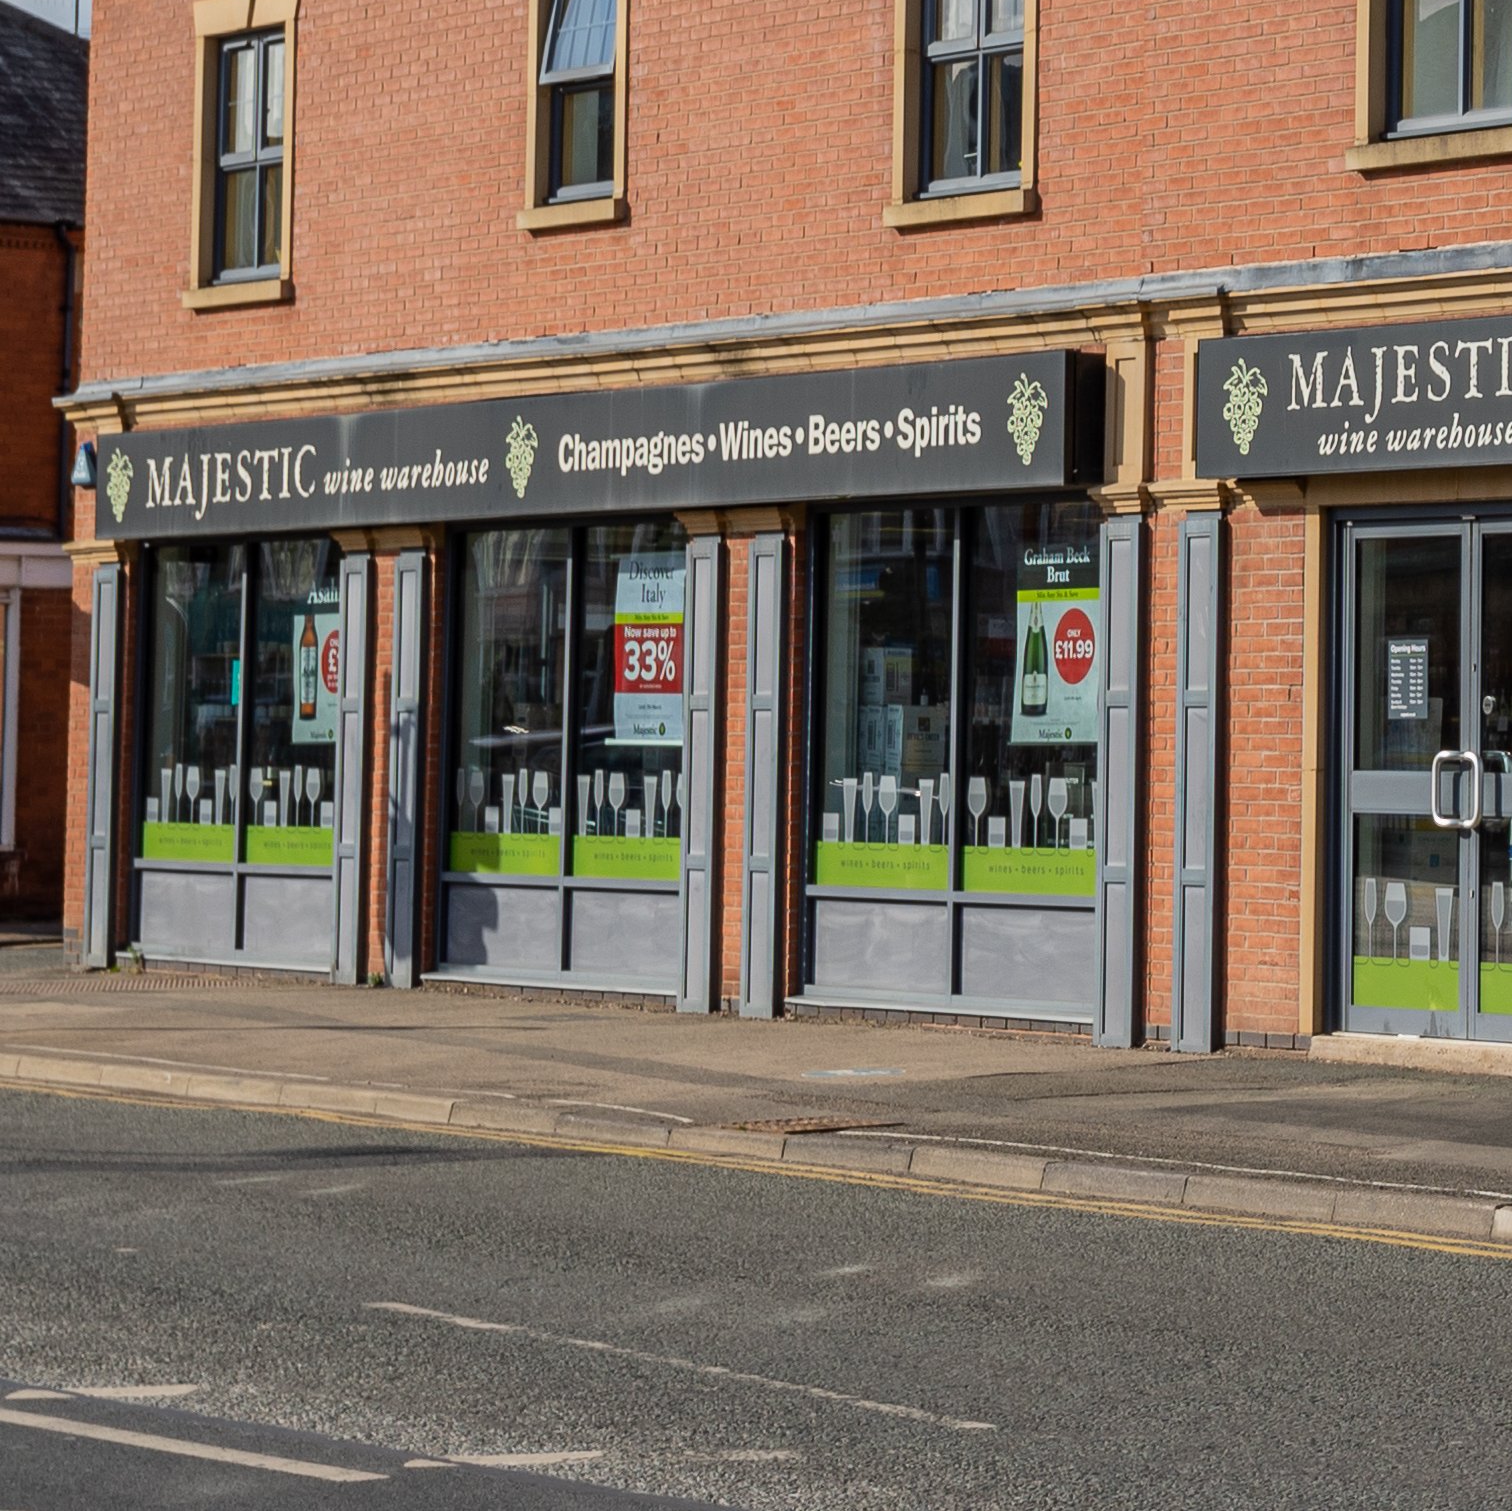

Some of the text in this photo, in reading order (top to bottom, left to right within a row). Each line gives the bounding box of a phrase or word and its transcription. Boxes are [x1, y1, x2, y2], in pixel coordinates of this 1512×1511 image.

[558, 405, 982, 476] Champagnes Wines Beers Spirits
[1317, 421, 1377, 456] wine
[146, 444, 489, 520] MAJESTIC wine warehouse
[1024, 545, 1090, 565] Graham Beck
[629, 561, 674, 580] Discover
[1047, 566, 1070, 583] Brut
[307, 578, 339, 604] Asah
[641, 582, 666, 608] Italy
[624, 640, 675, 681] 33%
[1055, 640, 1094, 659] £11.99
[988, 865, 1084, 876] wines beers spirits
